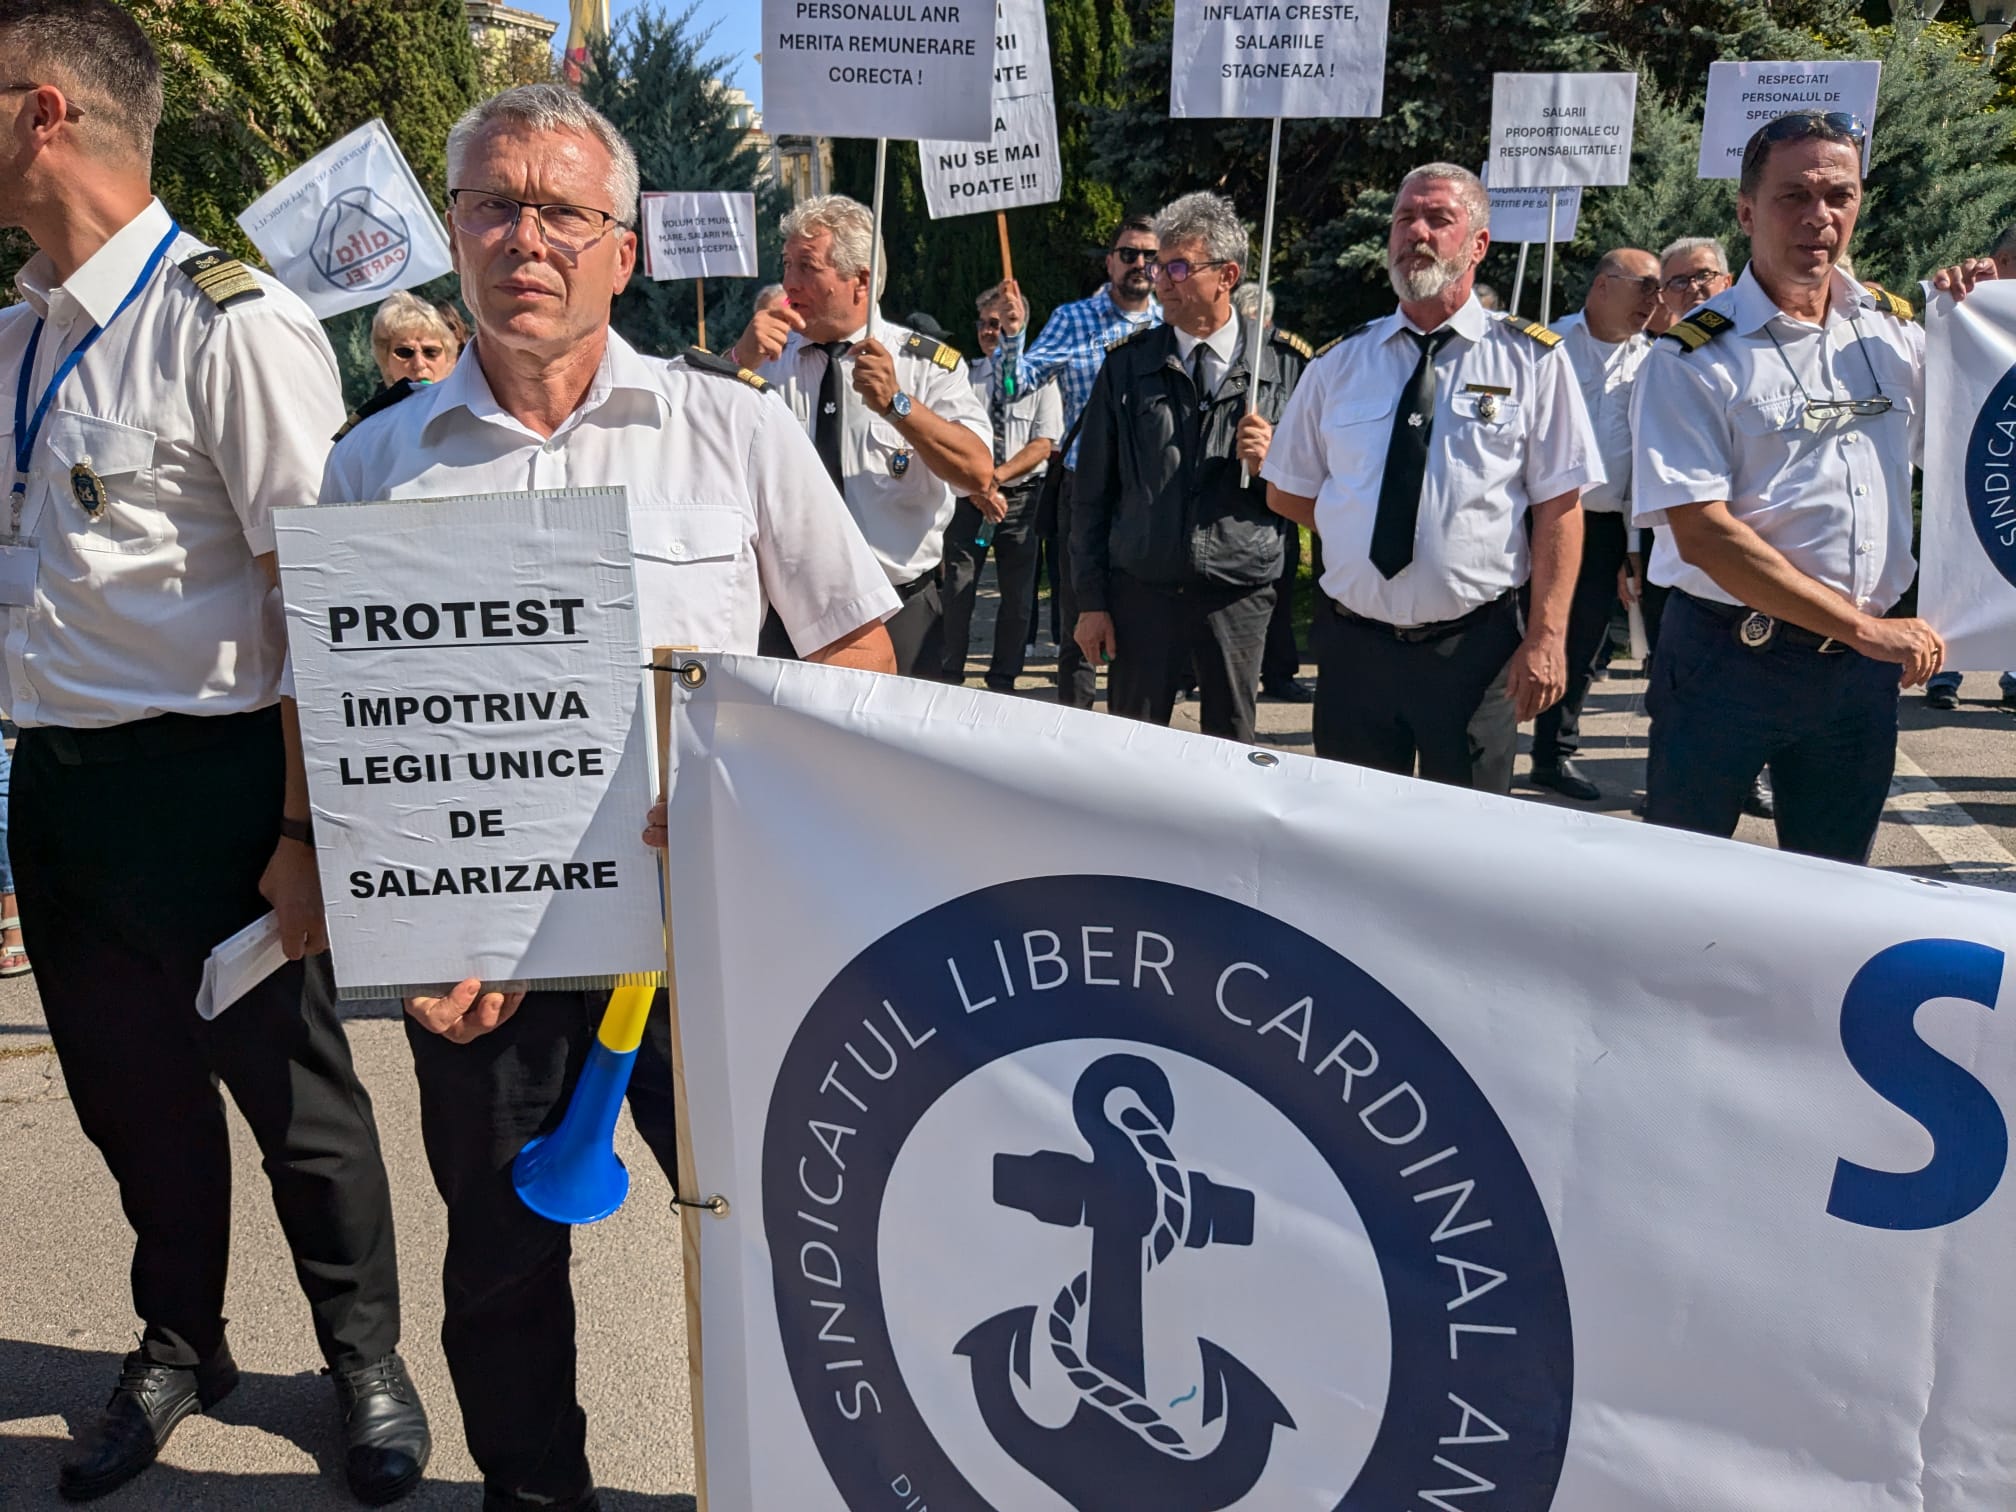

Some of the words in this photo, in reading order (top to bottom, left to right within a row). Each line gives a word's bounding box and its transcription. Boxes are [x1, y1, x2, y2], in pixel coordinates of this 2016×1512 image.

[796, 2, 916, 22] PERSONALUL
[921, 5, 960, 23] ANR
[1203, 6, 1281, 21] INFLATIA
[1286, 5, 1359, 22] CRESTE,
[779, 33, 844, 52] MERITA
[849, 35, 976, 56] REMUNERARE
[1235, 34, 1324, 49] SALARIILE
[829, 66, 913, 85] CORECTA
[1221, 63, 1325, 78] STAGNEAZA
[1758, 74, 1829, 85] RESPECTATI
[1742, 92, 1821, 102] PERSONALUL
[1824, 92, 1841, 102] DE
[1542, 106, 1586, 118] SALARII
[1505, 126, 1601, 138] PROPORTIONALE
[1603, 125, 1620, 136] CU
[939, 152, 968, 171] NU
[974, 149, 998, 166] SE
[1005, 143, 1041, 161] MAI
[1499, 145, 1617, 158] RESPONSABILITATILE
[949, 176, 1014, 199] POATE
[1020, 173, 1037, 190] !!!
[662, 217, 693, 228] VOLUM
[663, 247, 678, 256] NU
[678, 246, 695, 255] MAI
[328, 598, 586, 643] PROTEST
[340, 690, 589, 727] ÎMPOTRIVA
[339, 752, 451, 785] LEGII
[468, 747, 605, 780] UNICE
[449, 808, 506, 839] DE
[349, 860, 619, 899] SALARIZARE
[797, 999, 938, 1420] SINDICATUL
[947, 925, 1177, 1014] LIBER
[1215, 961, 1518, 1360] CARDINAL
[1417, 1391, 1510, 1512] AN
